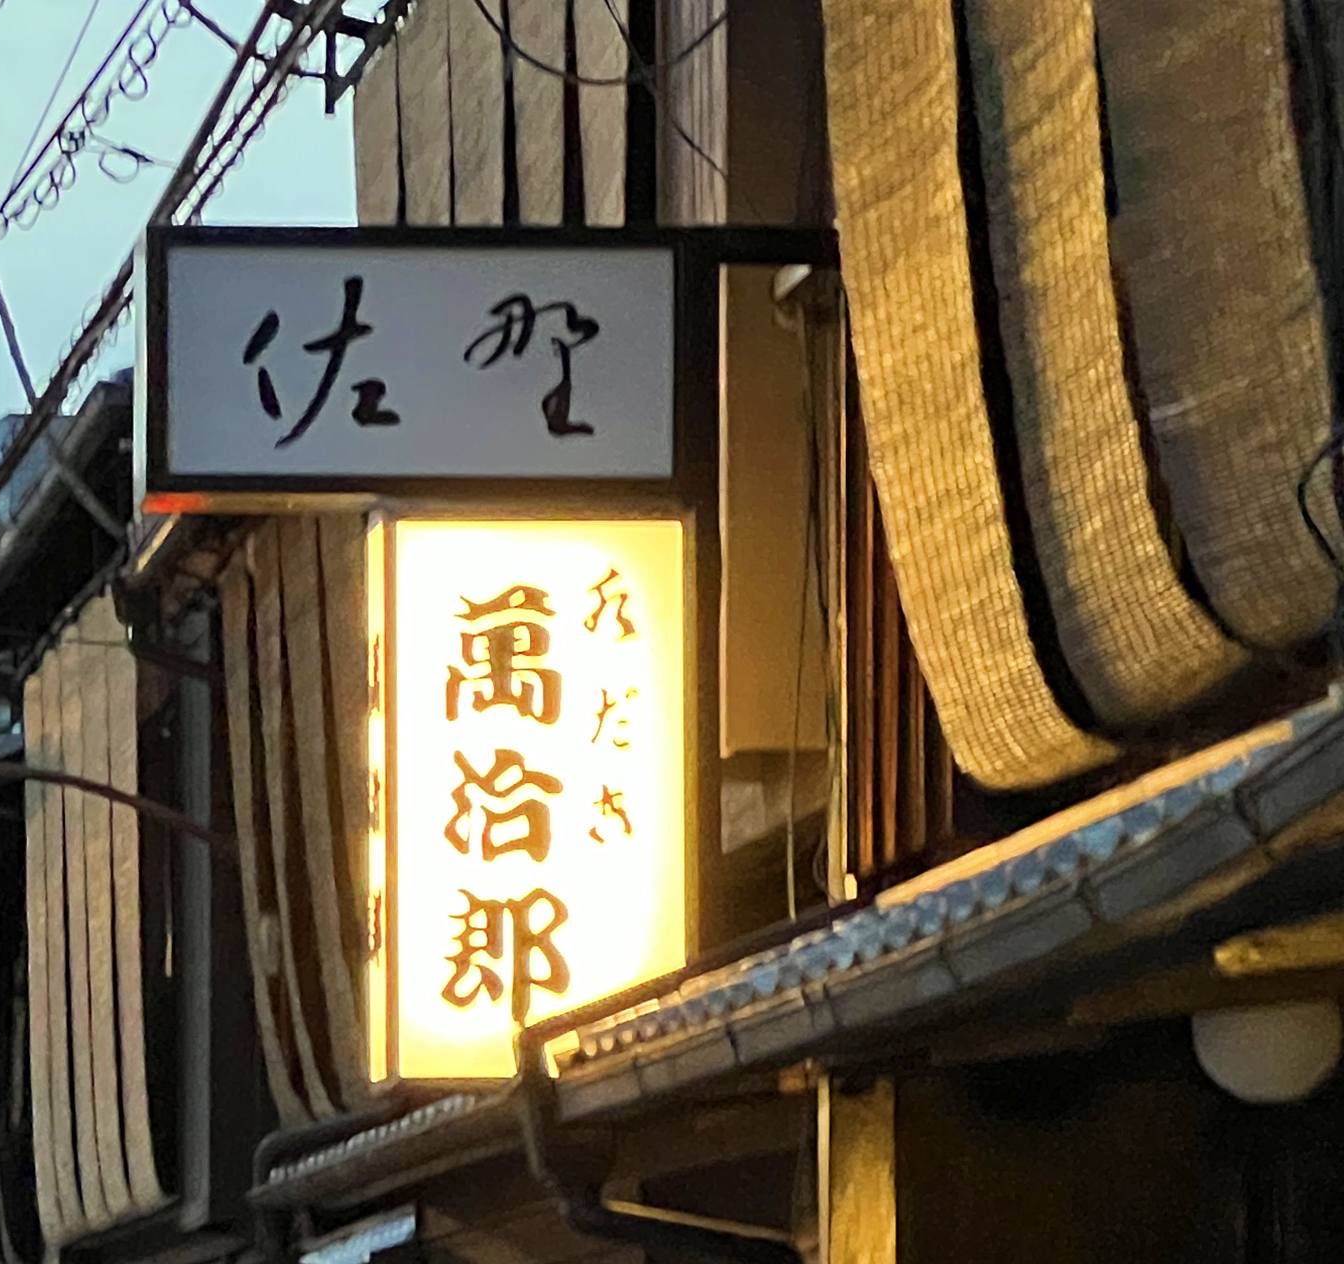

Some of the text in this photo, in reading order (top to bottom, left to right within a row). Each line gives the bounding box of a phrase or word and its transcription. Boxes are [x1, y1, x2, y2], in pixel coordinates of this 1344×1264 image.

[243, 275, 600, 448] 佐野
[443, 584, 571, 1024] 萬治郎
